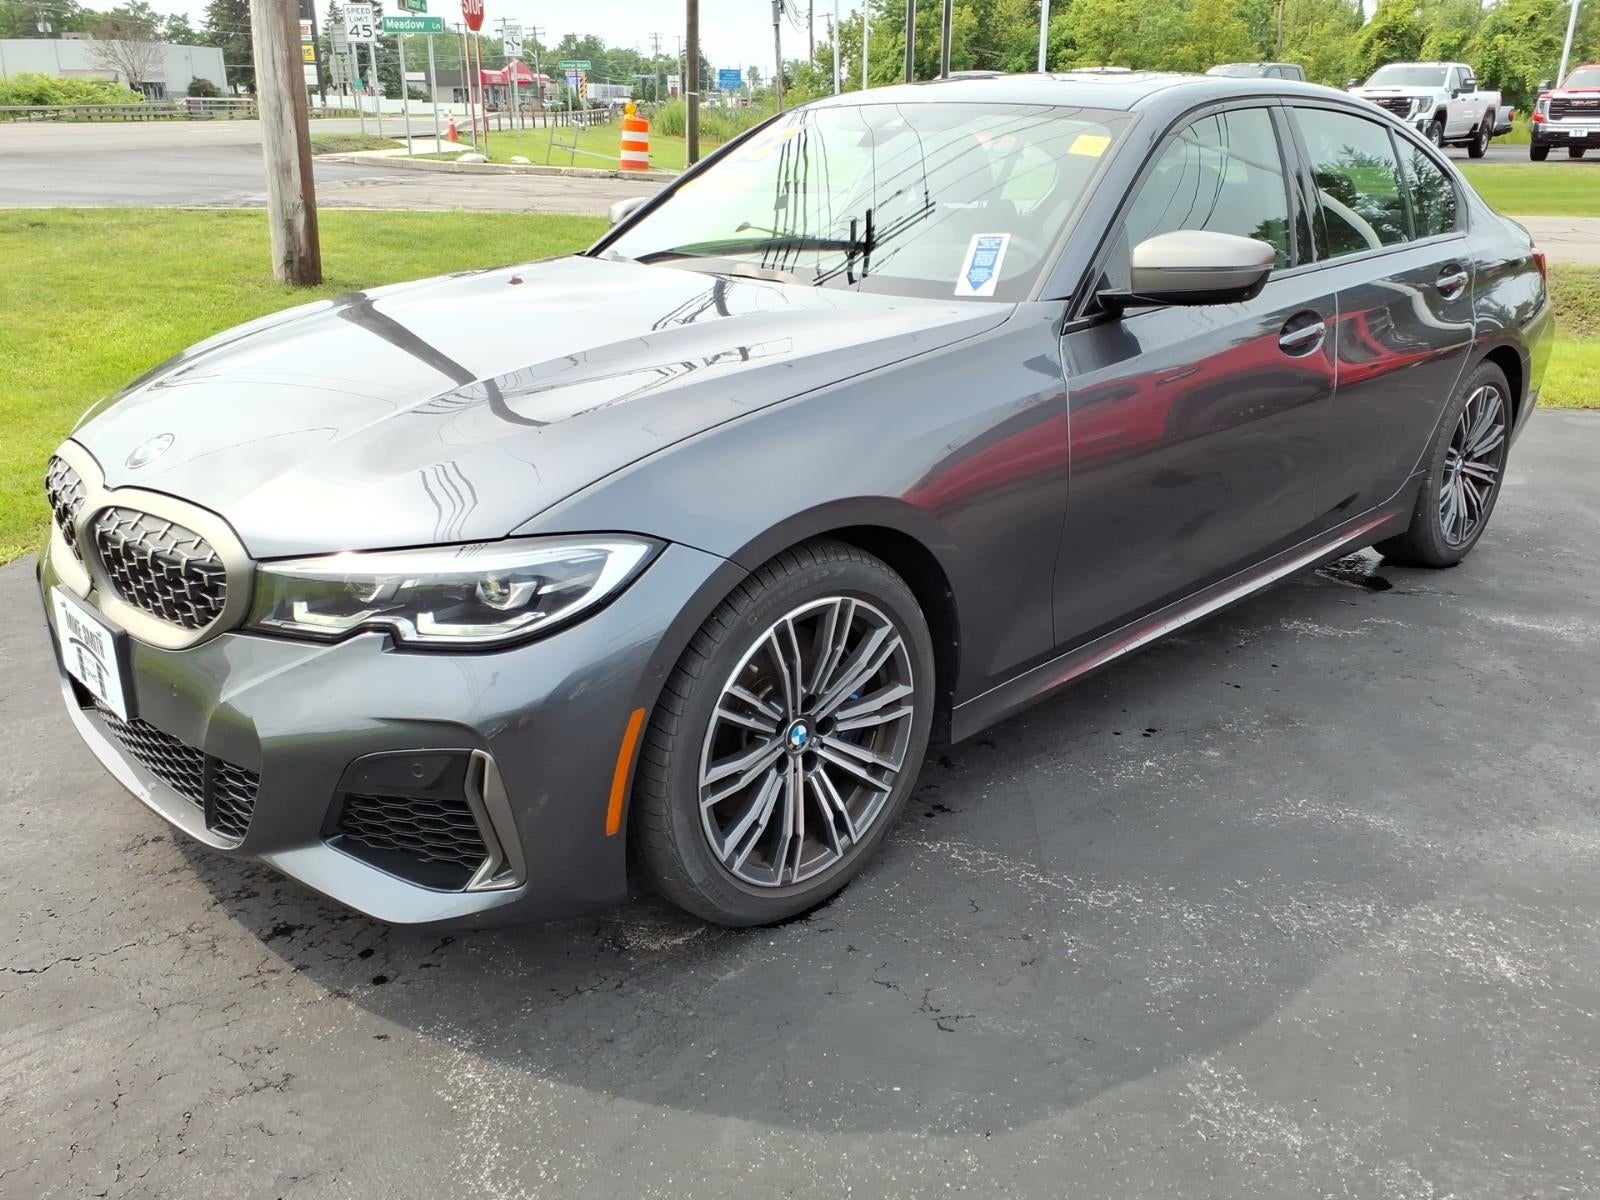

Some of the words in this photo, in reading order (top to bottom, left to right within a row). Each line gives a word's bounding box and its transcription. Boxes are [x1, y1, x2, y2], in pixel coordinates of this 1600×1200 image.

[346, 7, 371, 15] SPEED
[463, 0, 482, 15] STOP
[349, 24, 373, 38] 45
[386, 19, 425, 29] Meadow
[431, 22, 441, 30] Ln
[65, 609, 83, 641] MIKE
[82, 624, 106, 660] SMITH
